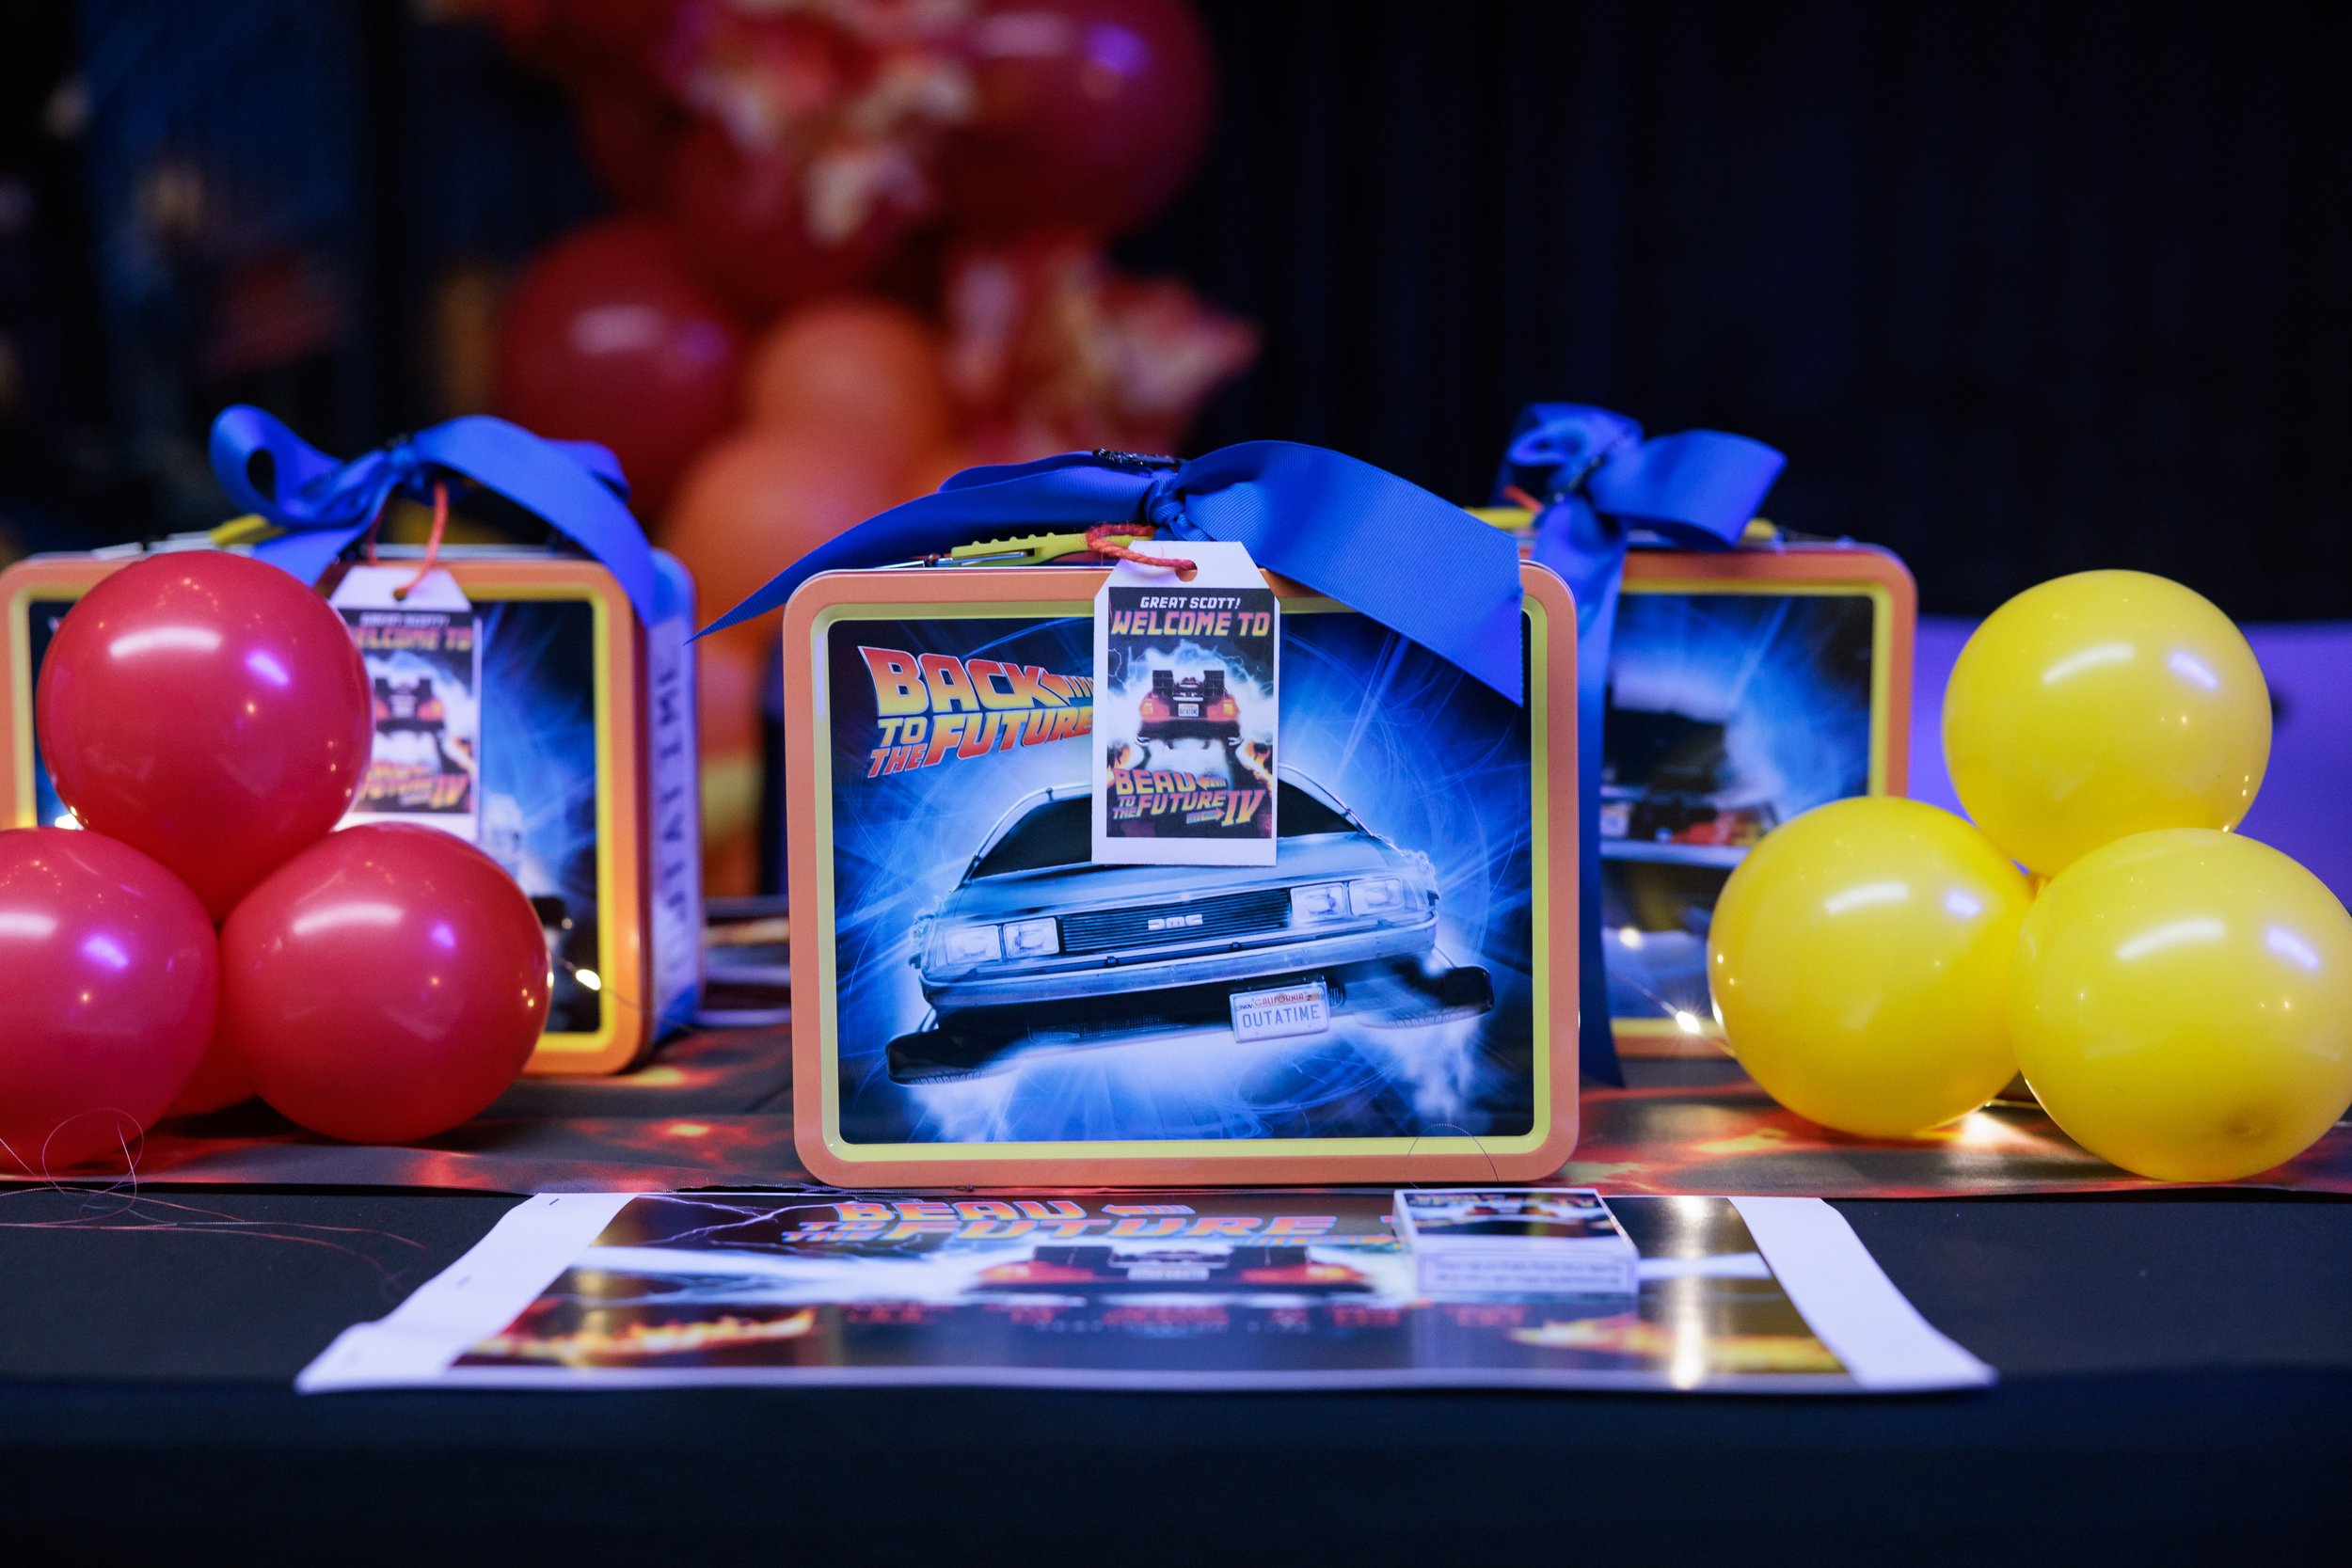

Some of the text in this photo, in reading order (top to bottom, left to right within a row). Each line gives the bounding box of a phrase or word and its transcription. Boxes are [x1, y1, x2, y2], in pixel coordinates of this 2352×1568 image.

[1140, 596, 1241, 610] GREAT SCOTT!
[1110, 610, 1271, 638] WELCOME TO
[349, 626, 439, 651] ELCOME
[857, 645, 1071, 717] BACK
[866, 705, 1094, 779] THE FUTURE
[877, 716, 928, 748] TO
[1113, 768, 1198, 796] BEAU
[1112, 789, 1266, 827] THE FUTURE IV
[1118, 795, 1136, 808] TO
[1254, 992, 1304, 1007] CALIFORNIA
[1242, 1004, 1321, 1028] OUTATIME
[833, 1201, 1087, 1222] BEAU
[878, 1216, 1337, 1241] FUTURE
